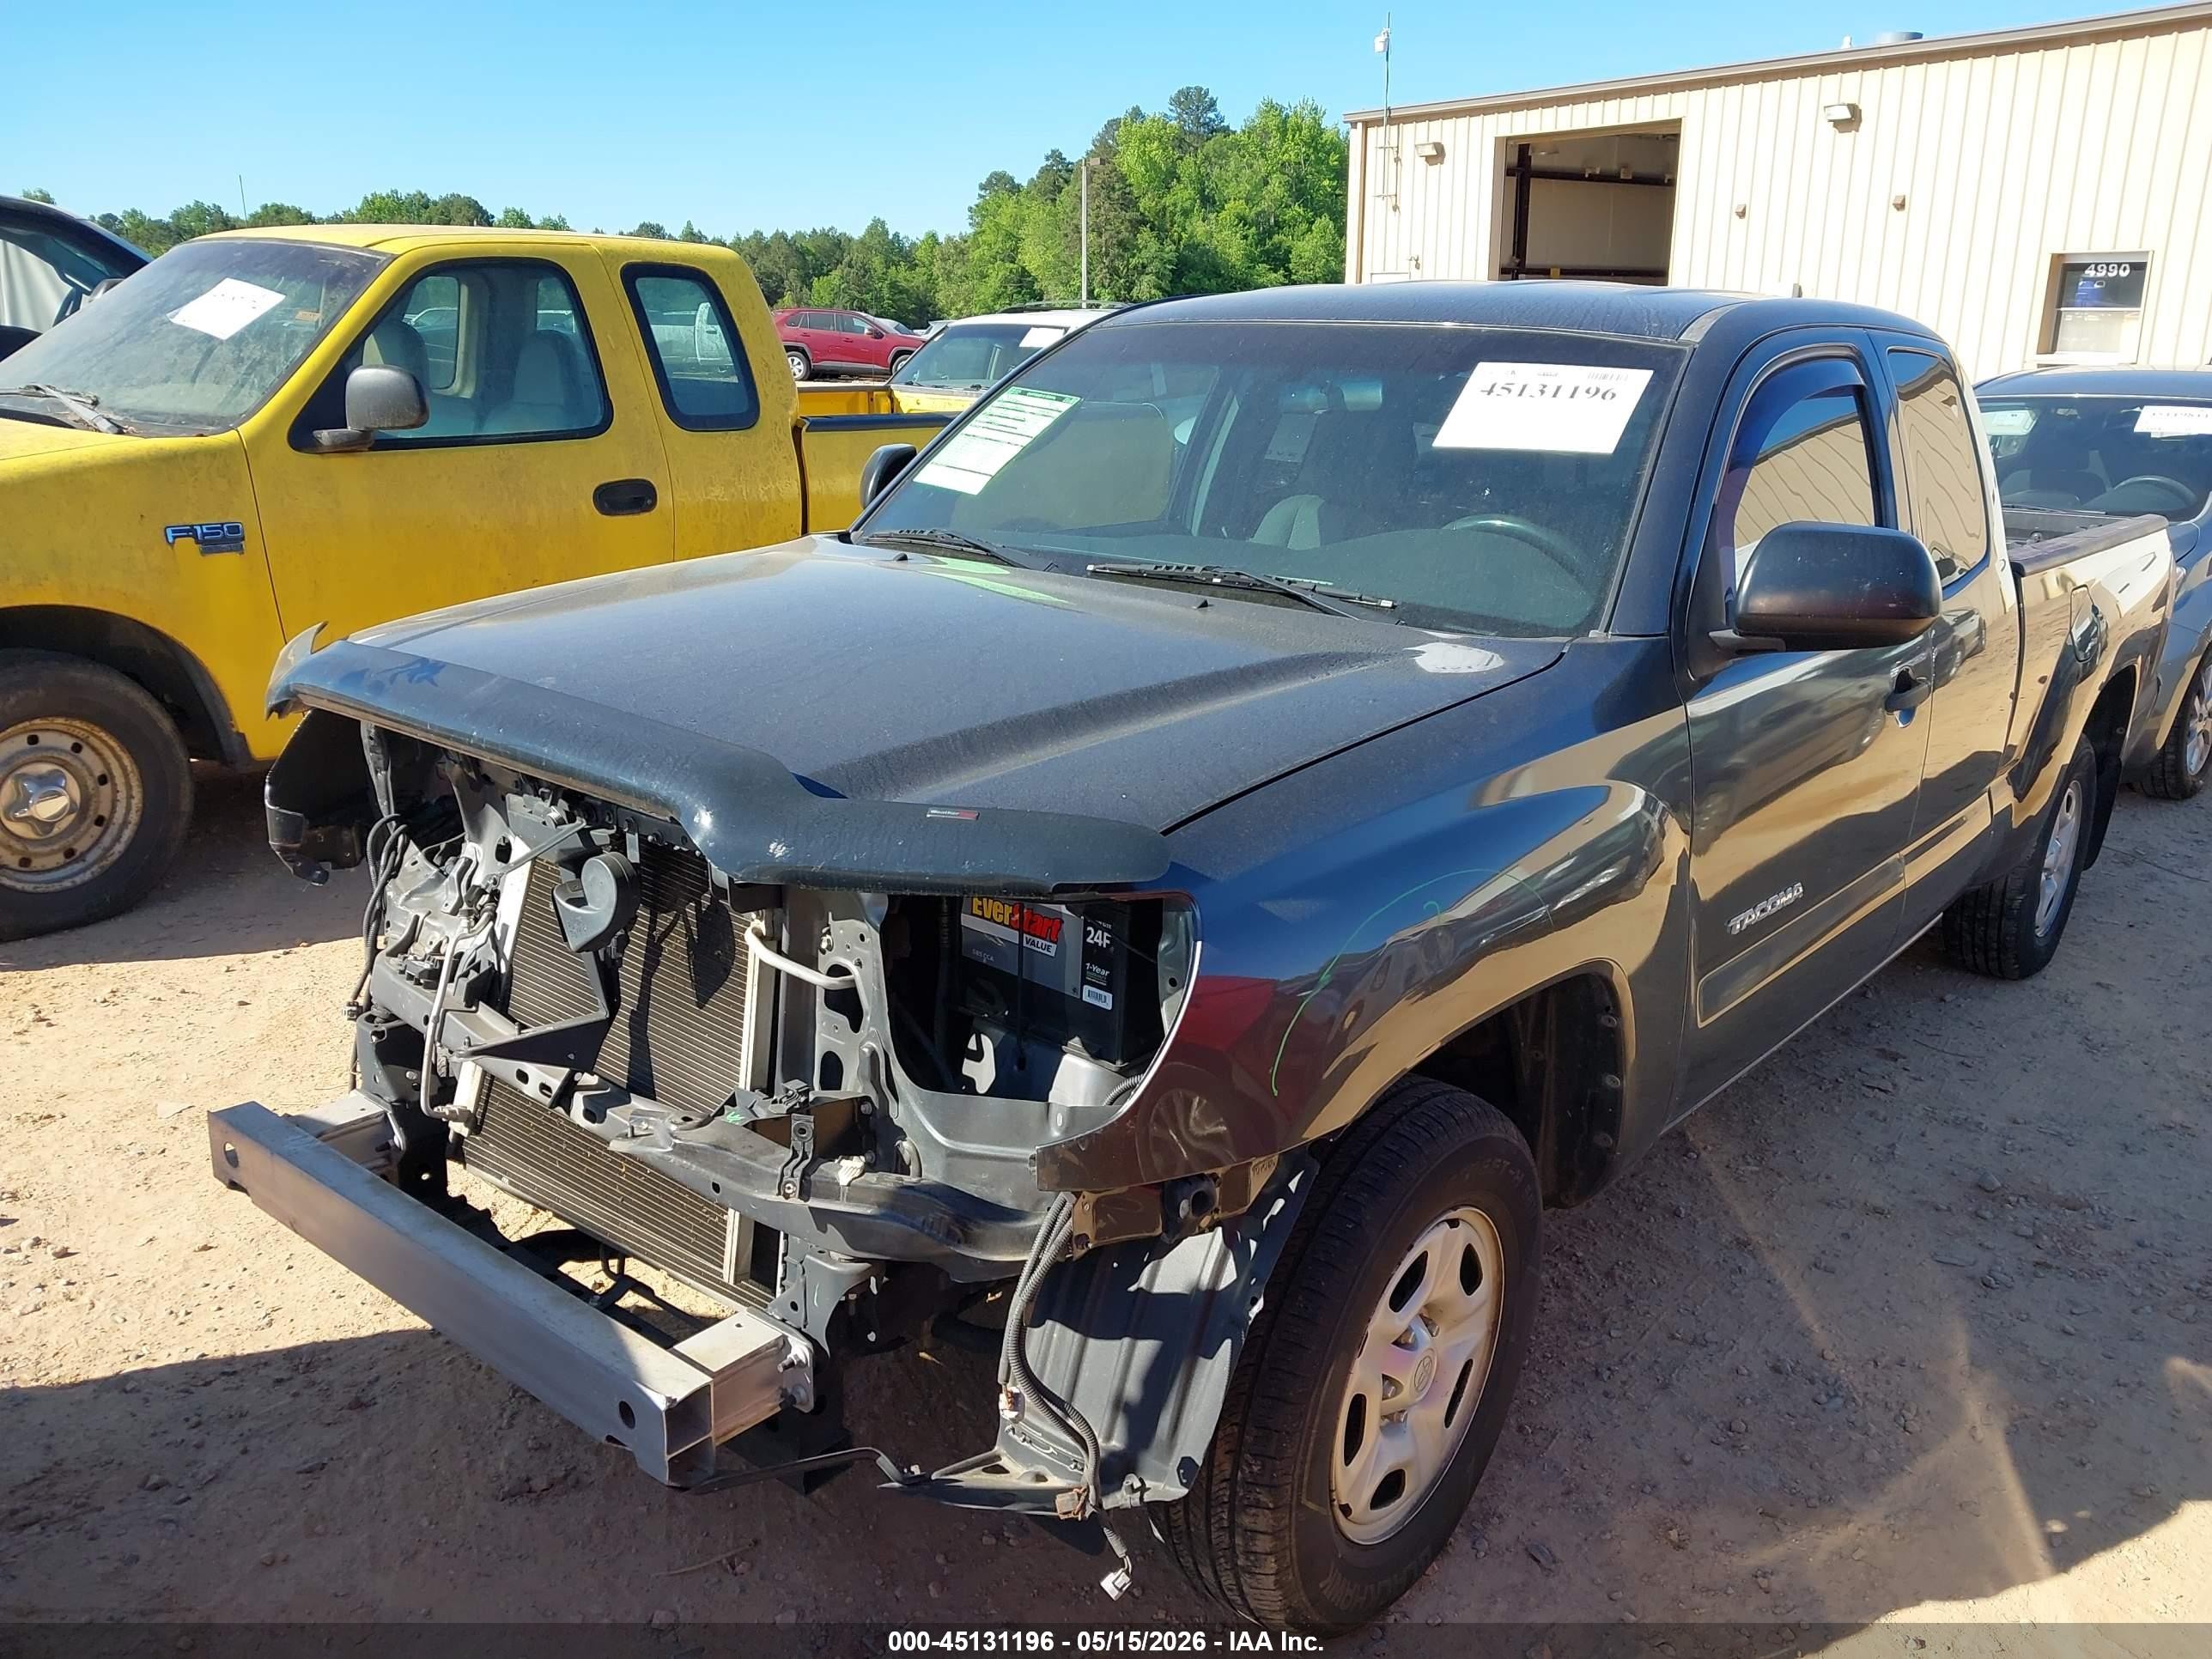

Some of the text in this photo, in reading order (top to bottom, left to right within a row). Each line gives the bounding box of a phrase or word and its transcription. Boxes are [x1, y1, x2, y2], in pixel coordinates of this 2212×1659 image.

[2084, 264, 2130, 277] 4990
[1480, 382, 1617, 401] 45131196
[1725, 882, 1803, 935] TACOMA
[971, 897, 1062, 943] EverStart
[1025, 936, 1053, 953] VALUE
[1085, 927, 1112, 948] 24F
[1085, 963, 1110, 976] 1-Year
